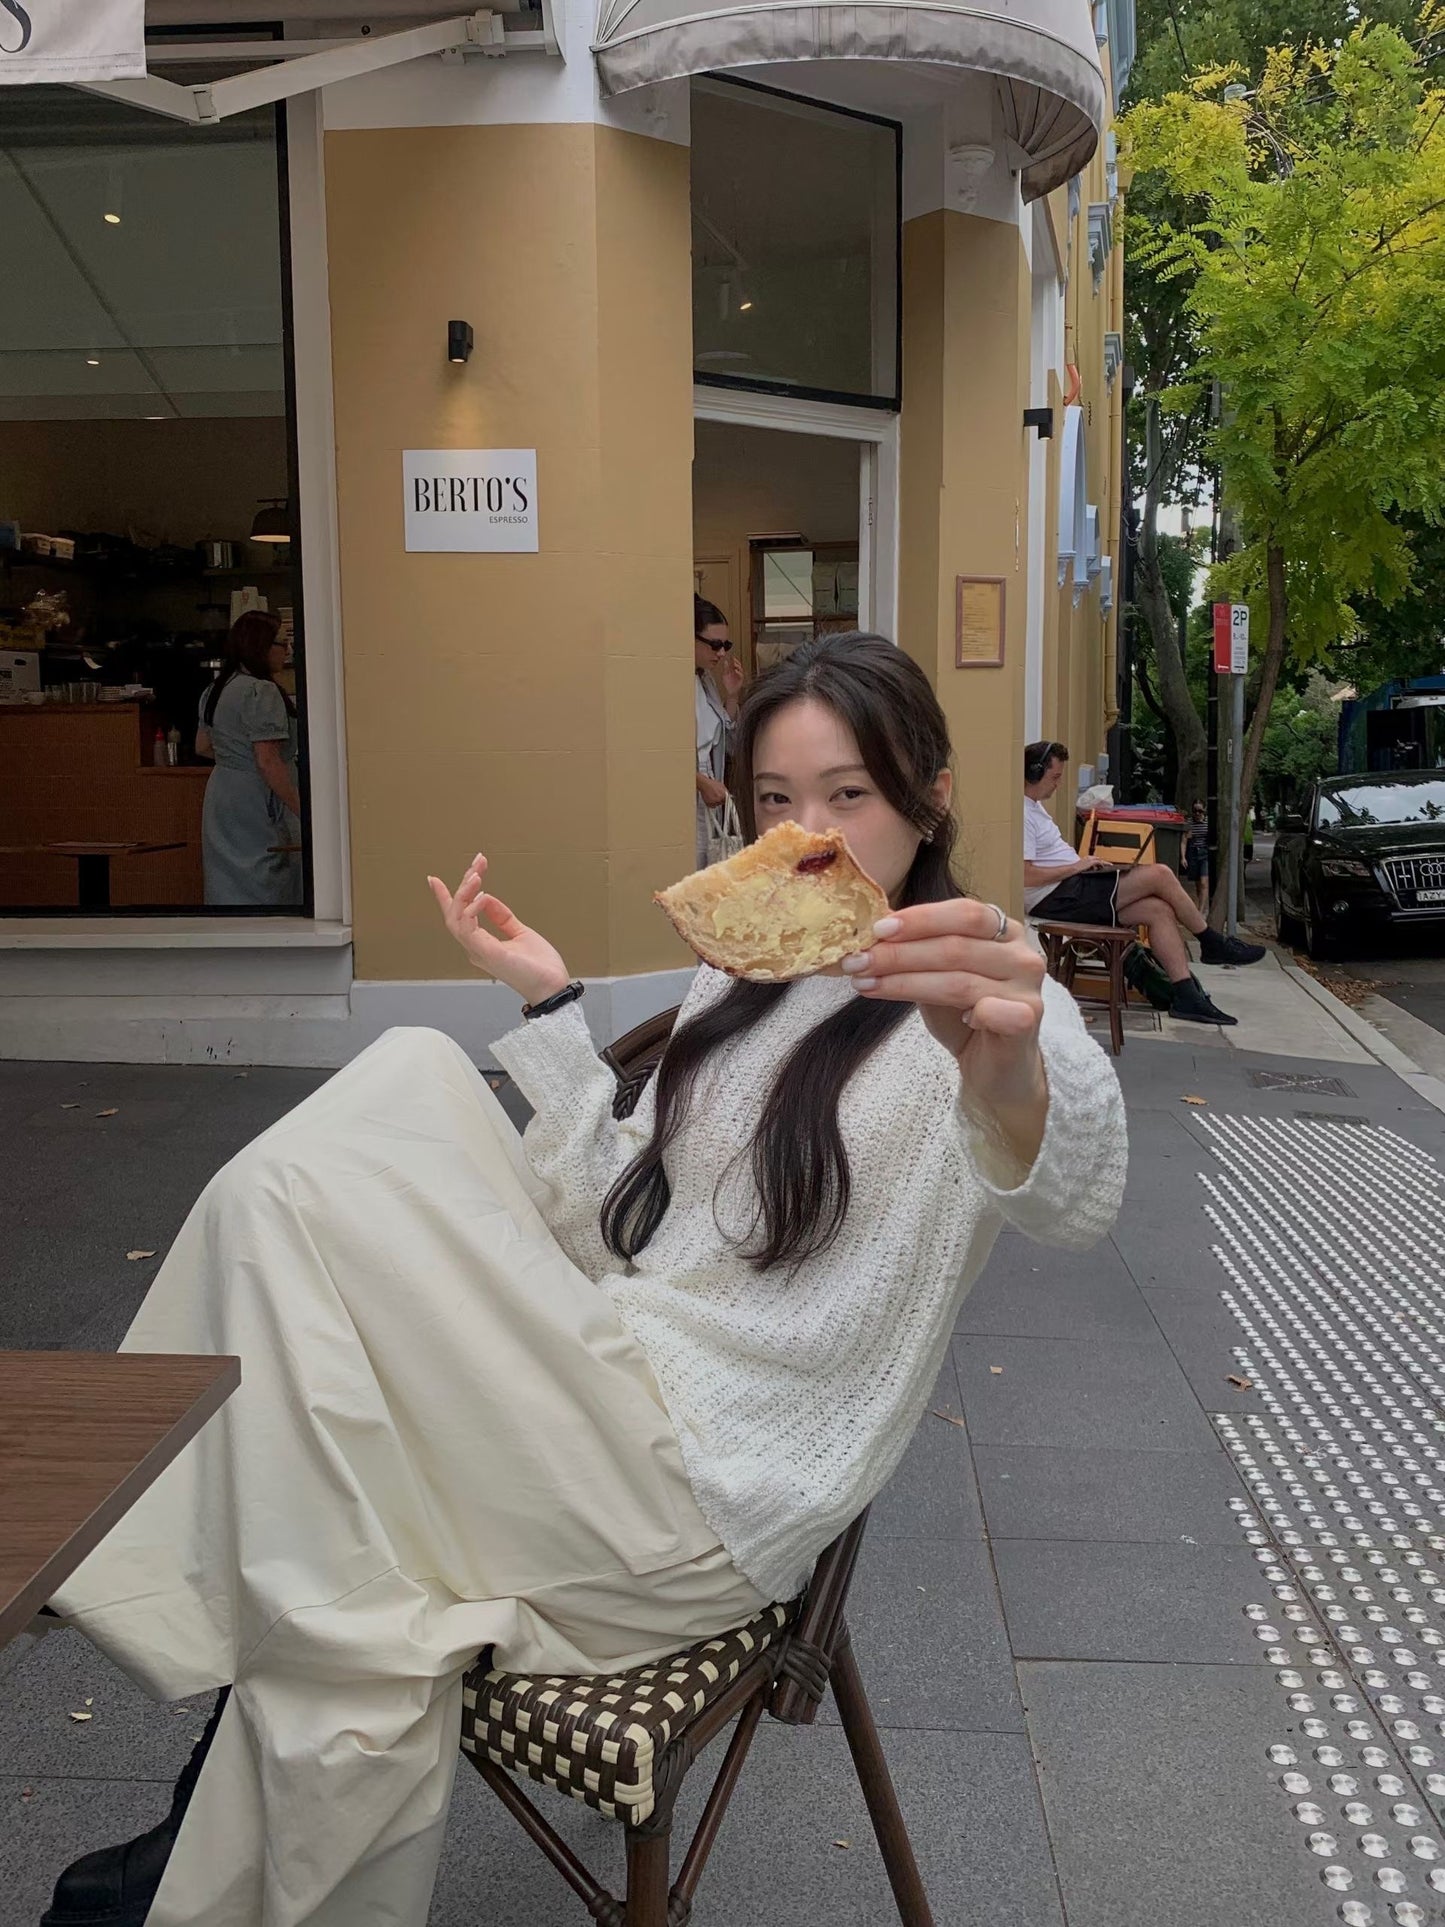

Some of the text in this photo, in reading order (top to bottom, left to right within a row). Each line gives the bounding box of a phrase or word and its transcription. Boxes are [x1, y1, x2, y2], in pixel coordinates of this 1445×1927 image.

[412, 476, 528, 513] BERTO'S
[489, 516, 529, 524] ESPRESSO
[1232, 610, 1248, 627] 2P
